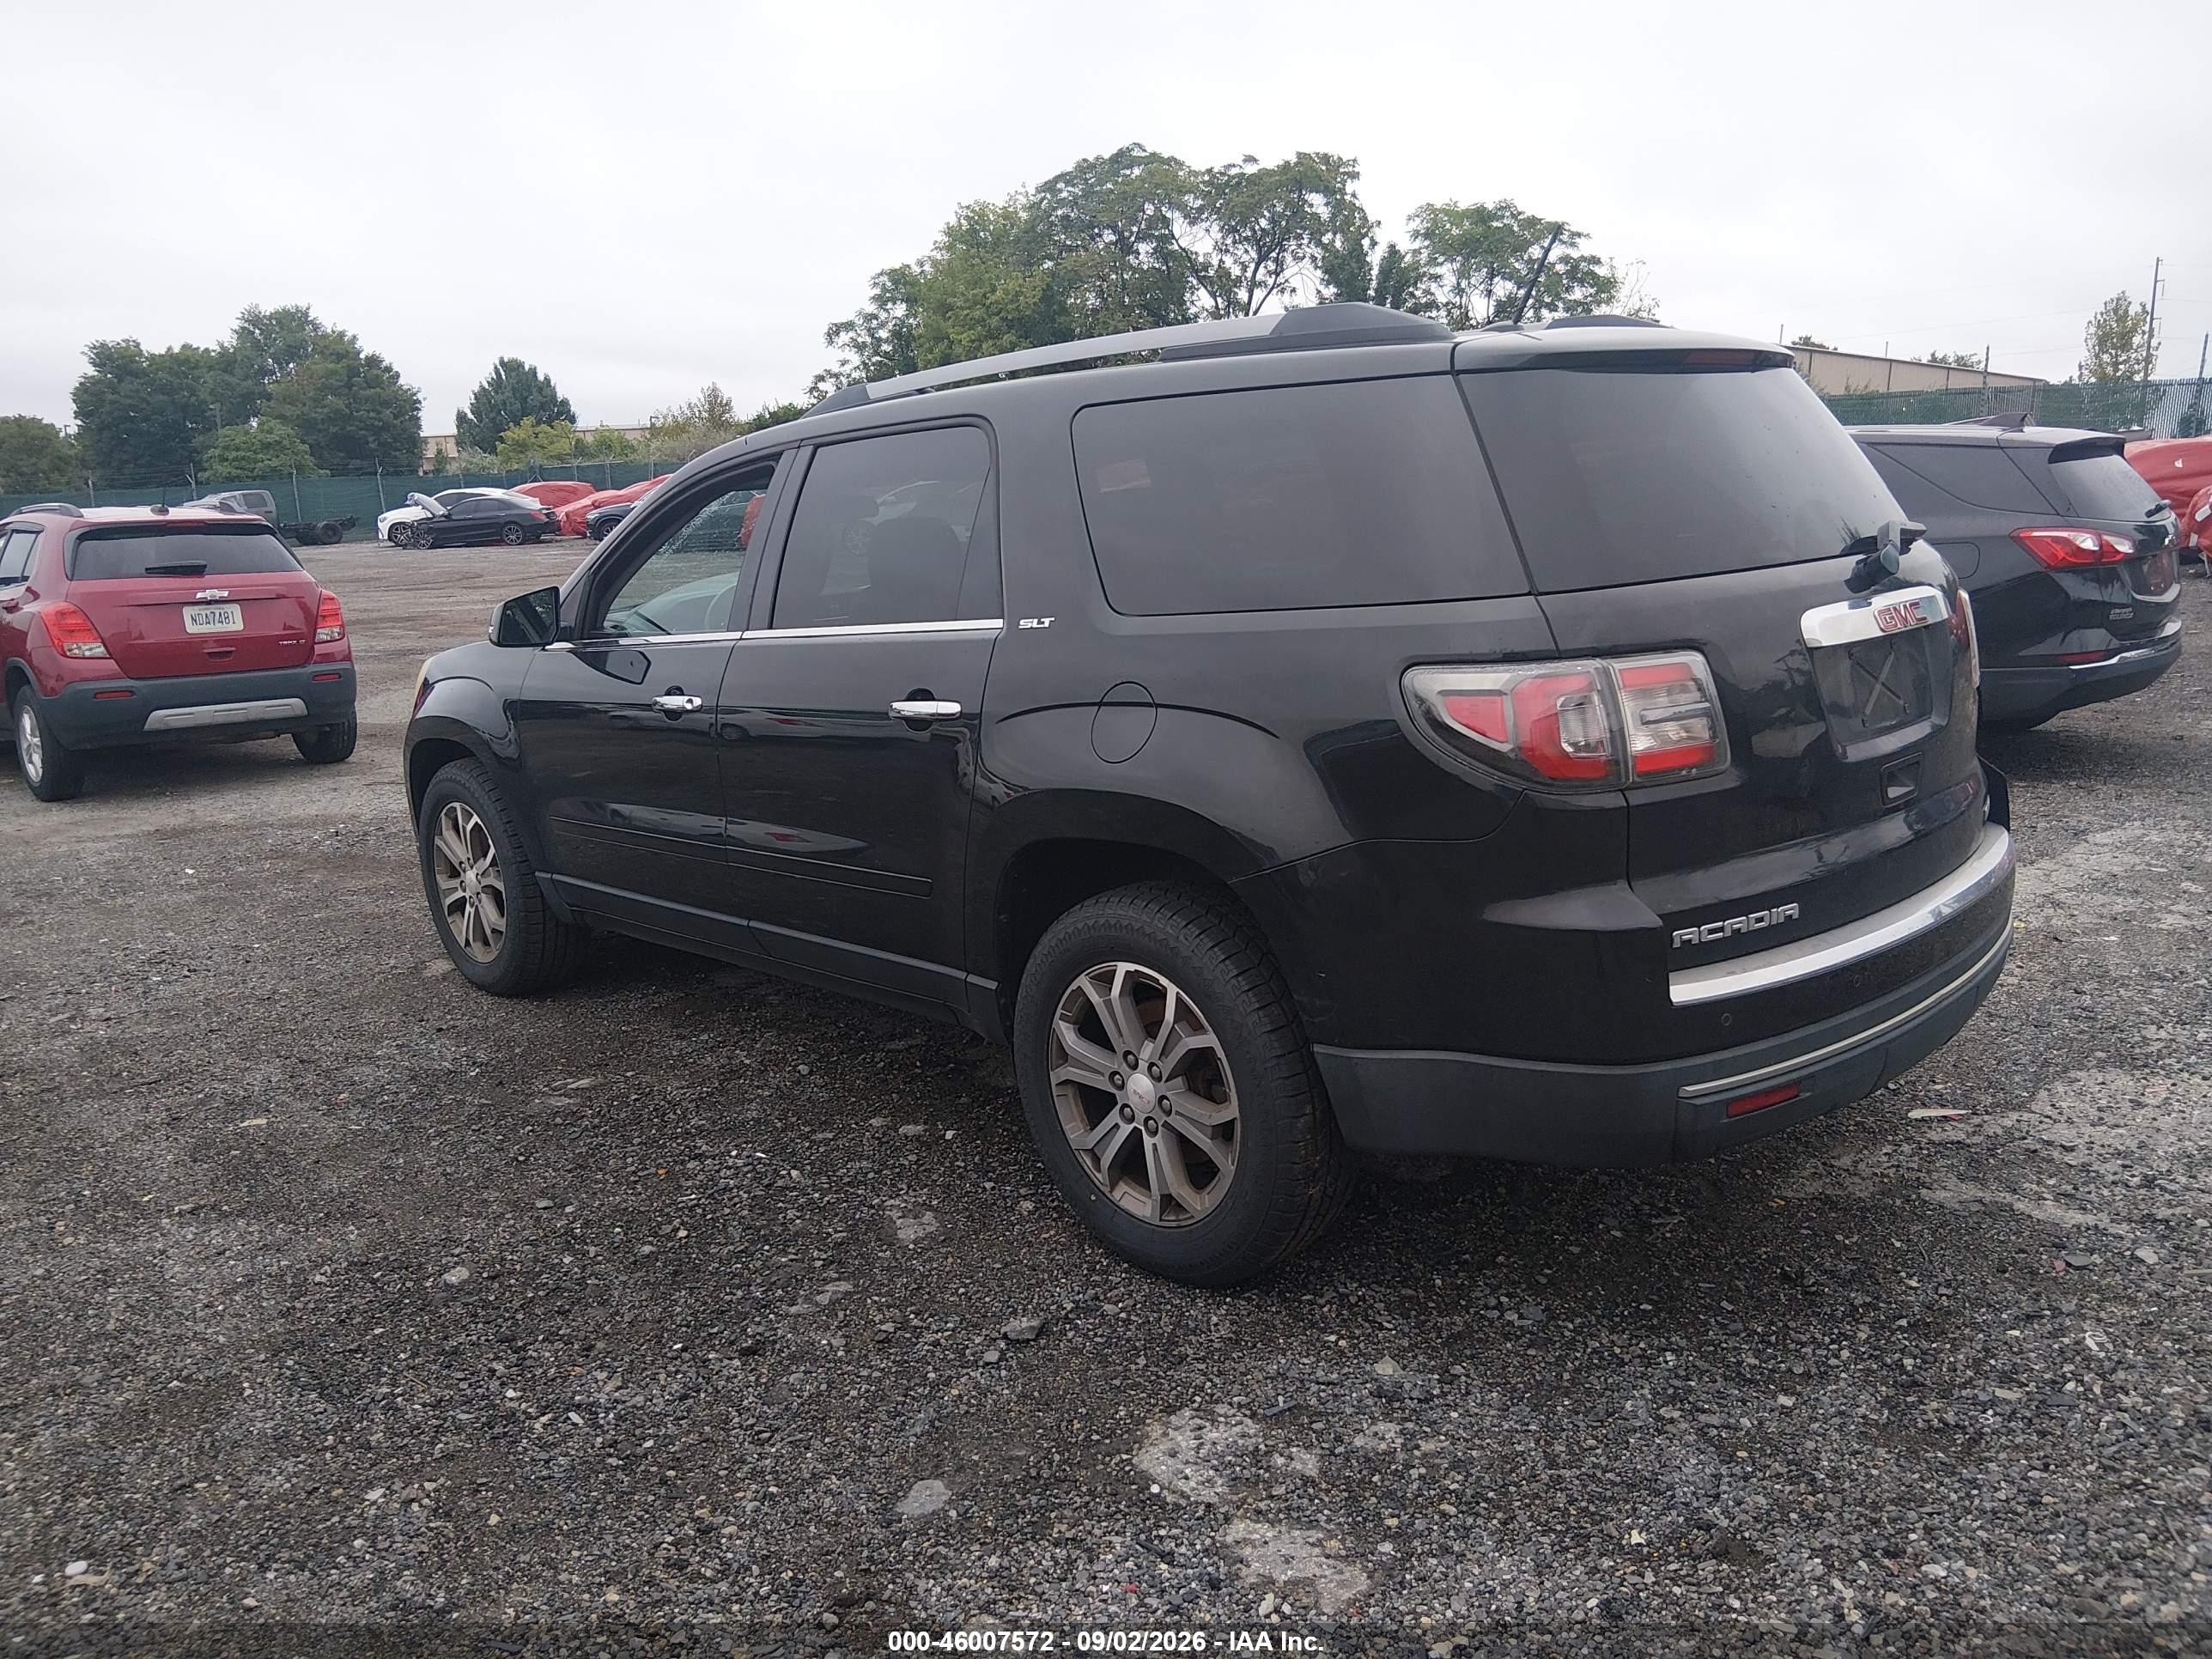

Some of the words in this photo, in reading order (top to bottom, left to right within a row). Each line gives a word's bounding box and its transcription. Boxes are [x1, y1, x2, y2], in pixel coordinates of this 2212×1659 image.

[190, 611, 236, 626] NDA7481
[1018, 617, 1055, 629] SLT
[1875, 601, 1929, 632] GMC
[1672, 902, 1799, 948] ACADIA
